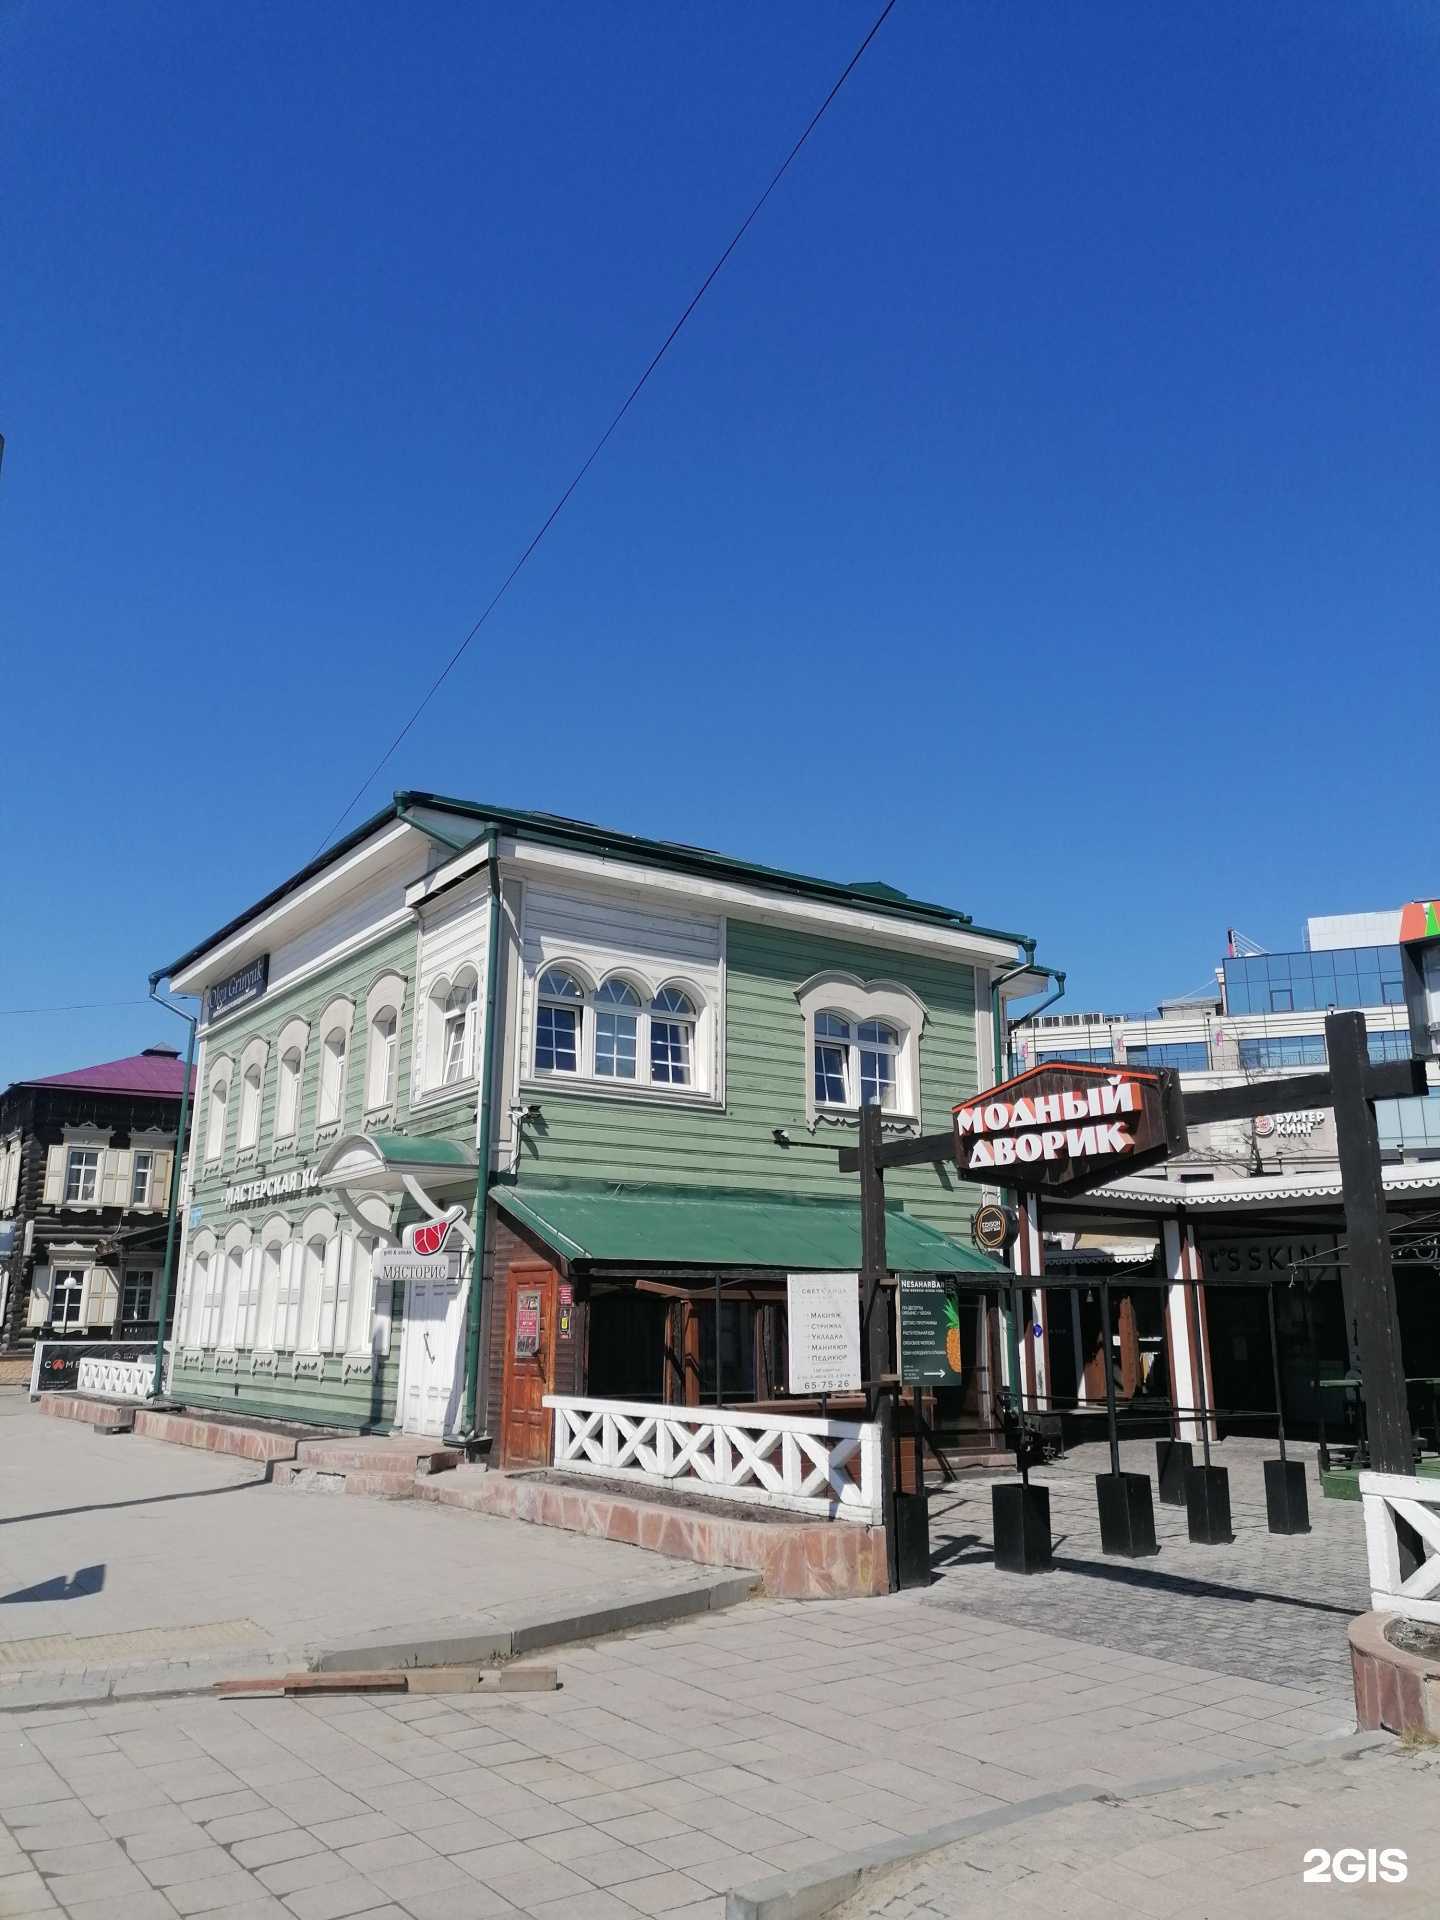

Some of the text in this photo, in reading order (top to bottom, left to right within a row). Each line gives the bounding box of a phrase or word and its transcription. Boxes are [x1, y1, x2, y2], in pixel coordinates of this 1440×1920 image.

[957, 1074, 1136, 1137] МОДНЫЙ
[1276, 1111, 1325, 1123] БУРГЕР
[1276, 1123, 1314, 1135] КИНГ
[968, 1121, 1133, 1169] ДВОРИК
[225, 1172, 300, 1207] МАСТЕРСКАЯ
[383, 1265, 447, 1280] МЯСТОРИС
